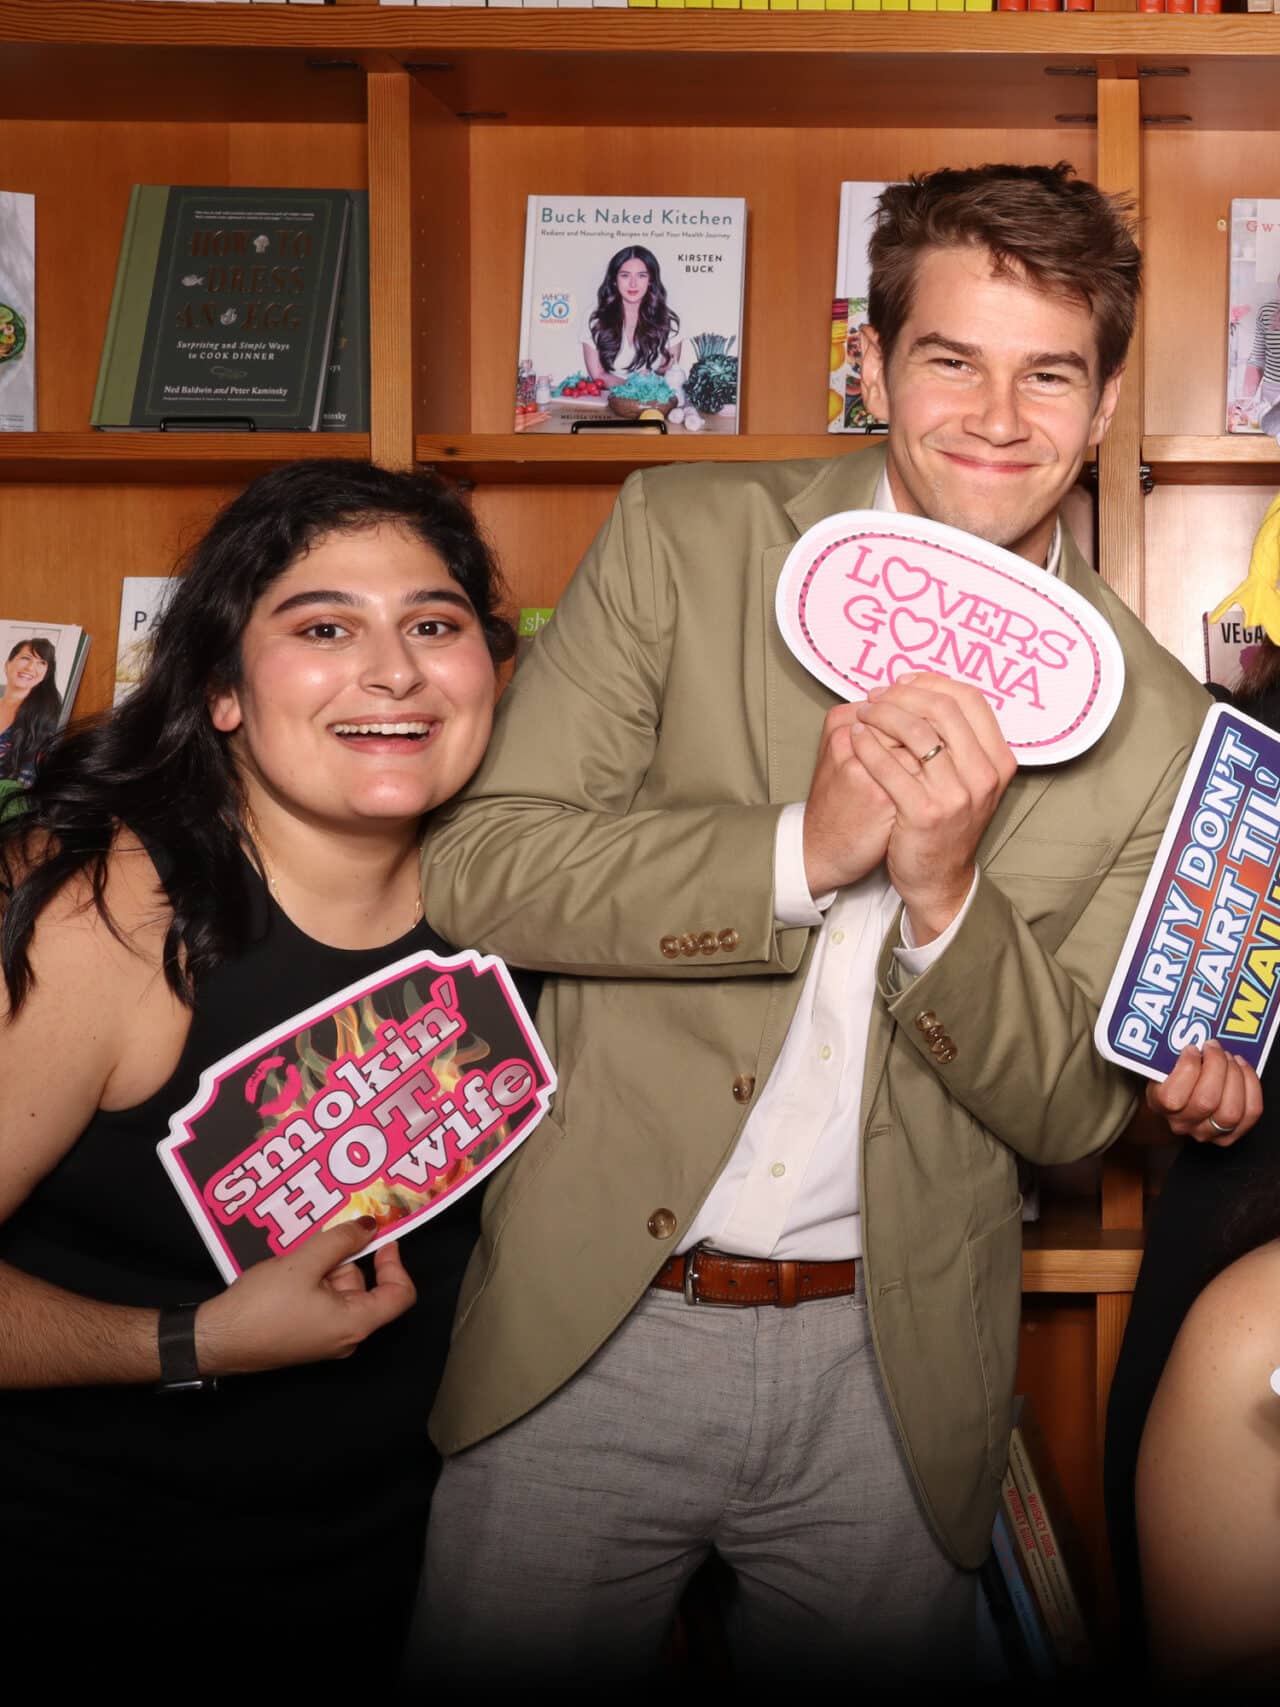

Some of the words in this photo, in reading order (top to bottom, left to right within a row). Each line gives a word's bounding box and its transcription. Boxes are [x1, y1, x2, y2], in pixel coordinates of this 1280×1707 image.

[542, 208, 586, 223] Buck
[595, 209, 653, 225] Naked
[661, 209, 732, 225] Kitchen
[190, 229, 253, 257] HOW
[273, 230, 312, 258] TO
[580, 231, 615, 239] Nourishing
[616, 231, 640, 239] Recipes
[705, 232, 731, 240] Journey
[677, 254, 723, 262] KIRSTEN
[685, 265, 714, 273] BUCK
[205, 264, 305, 294] DRESS
[175, 302, 217, 328] AN
[241, 302, 302, 329] EGG
[176, 340, 219, 351] Surprising
[222, 341, 236, 350] and
[240, 341, 266, 351] Simple
[269, 341, 290, 351] Ways
[188, 352, 197, 360] to
[200, 352, 228, 360] COOK
[232, 352, 275, 361] DINNER
[164, 385, 180, 394] Ned
[182, 385, 212, 395] Baldwin
[213, 386, 228, 395] and
[230, 387, 250, 395] Peter
[251, 387, 288, 396] Kaminsky
[845, 546, 1078, 670] LOVERS
[1220, 622, 1265, 643] VEGA
[843, 595, 1046, 710] GONNA
[1115, 883, 1203, 1059] PARTY
[1176, 727, 1258, 889] DON'T
[1168, 865, 1259, 1055] START
[212, 980, 461, 1216] smokin'
[385, 1063, 533, 1187] wife
[254, 1069, 436, 1249] HOT
